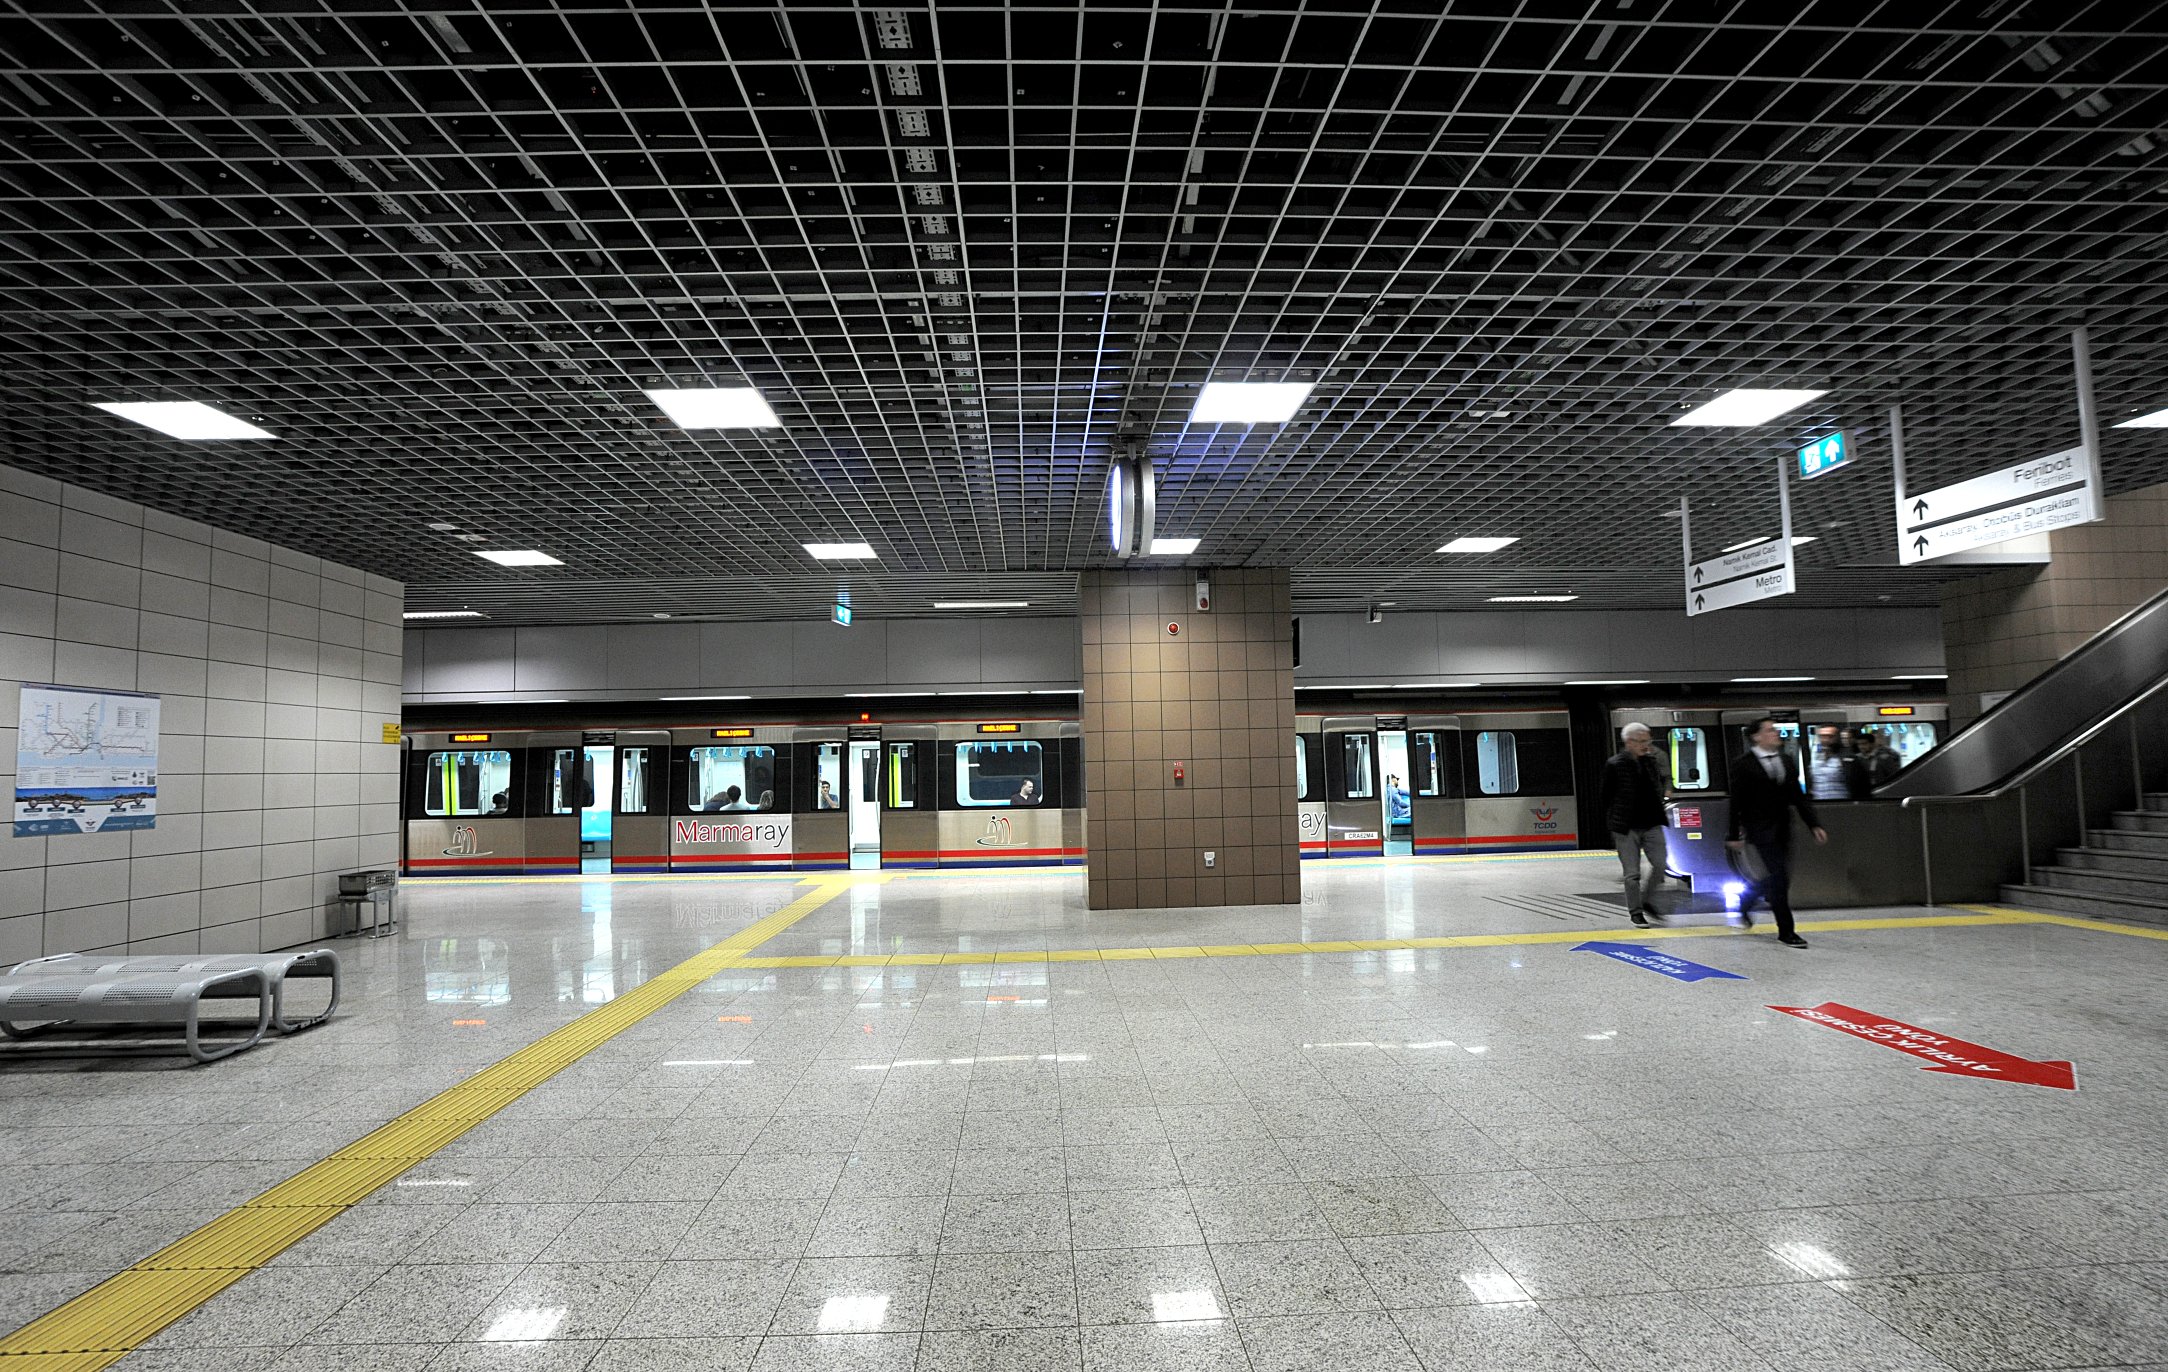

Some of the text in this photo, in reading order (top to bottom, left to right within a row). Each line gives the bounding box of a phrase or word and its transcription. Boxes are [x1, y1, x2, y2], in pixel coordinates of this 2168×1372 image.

[2014, 455, 2072, 483] Feribot
[2034, 471, 2073, 489] Ferries
[2023, 516, 2045, 532] Bus
[1756, 575, 1782, 588] Metro
[675, 819, 790, 849] Marmaray
[1533, 822, 1557, 830] TCDD
[1874, 1022, 1950, 1047] YÖNÜ
[1889, 1039, 2003, 1073] AYRILIK
